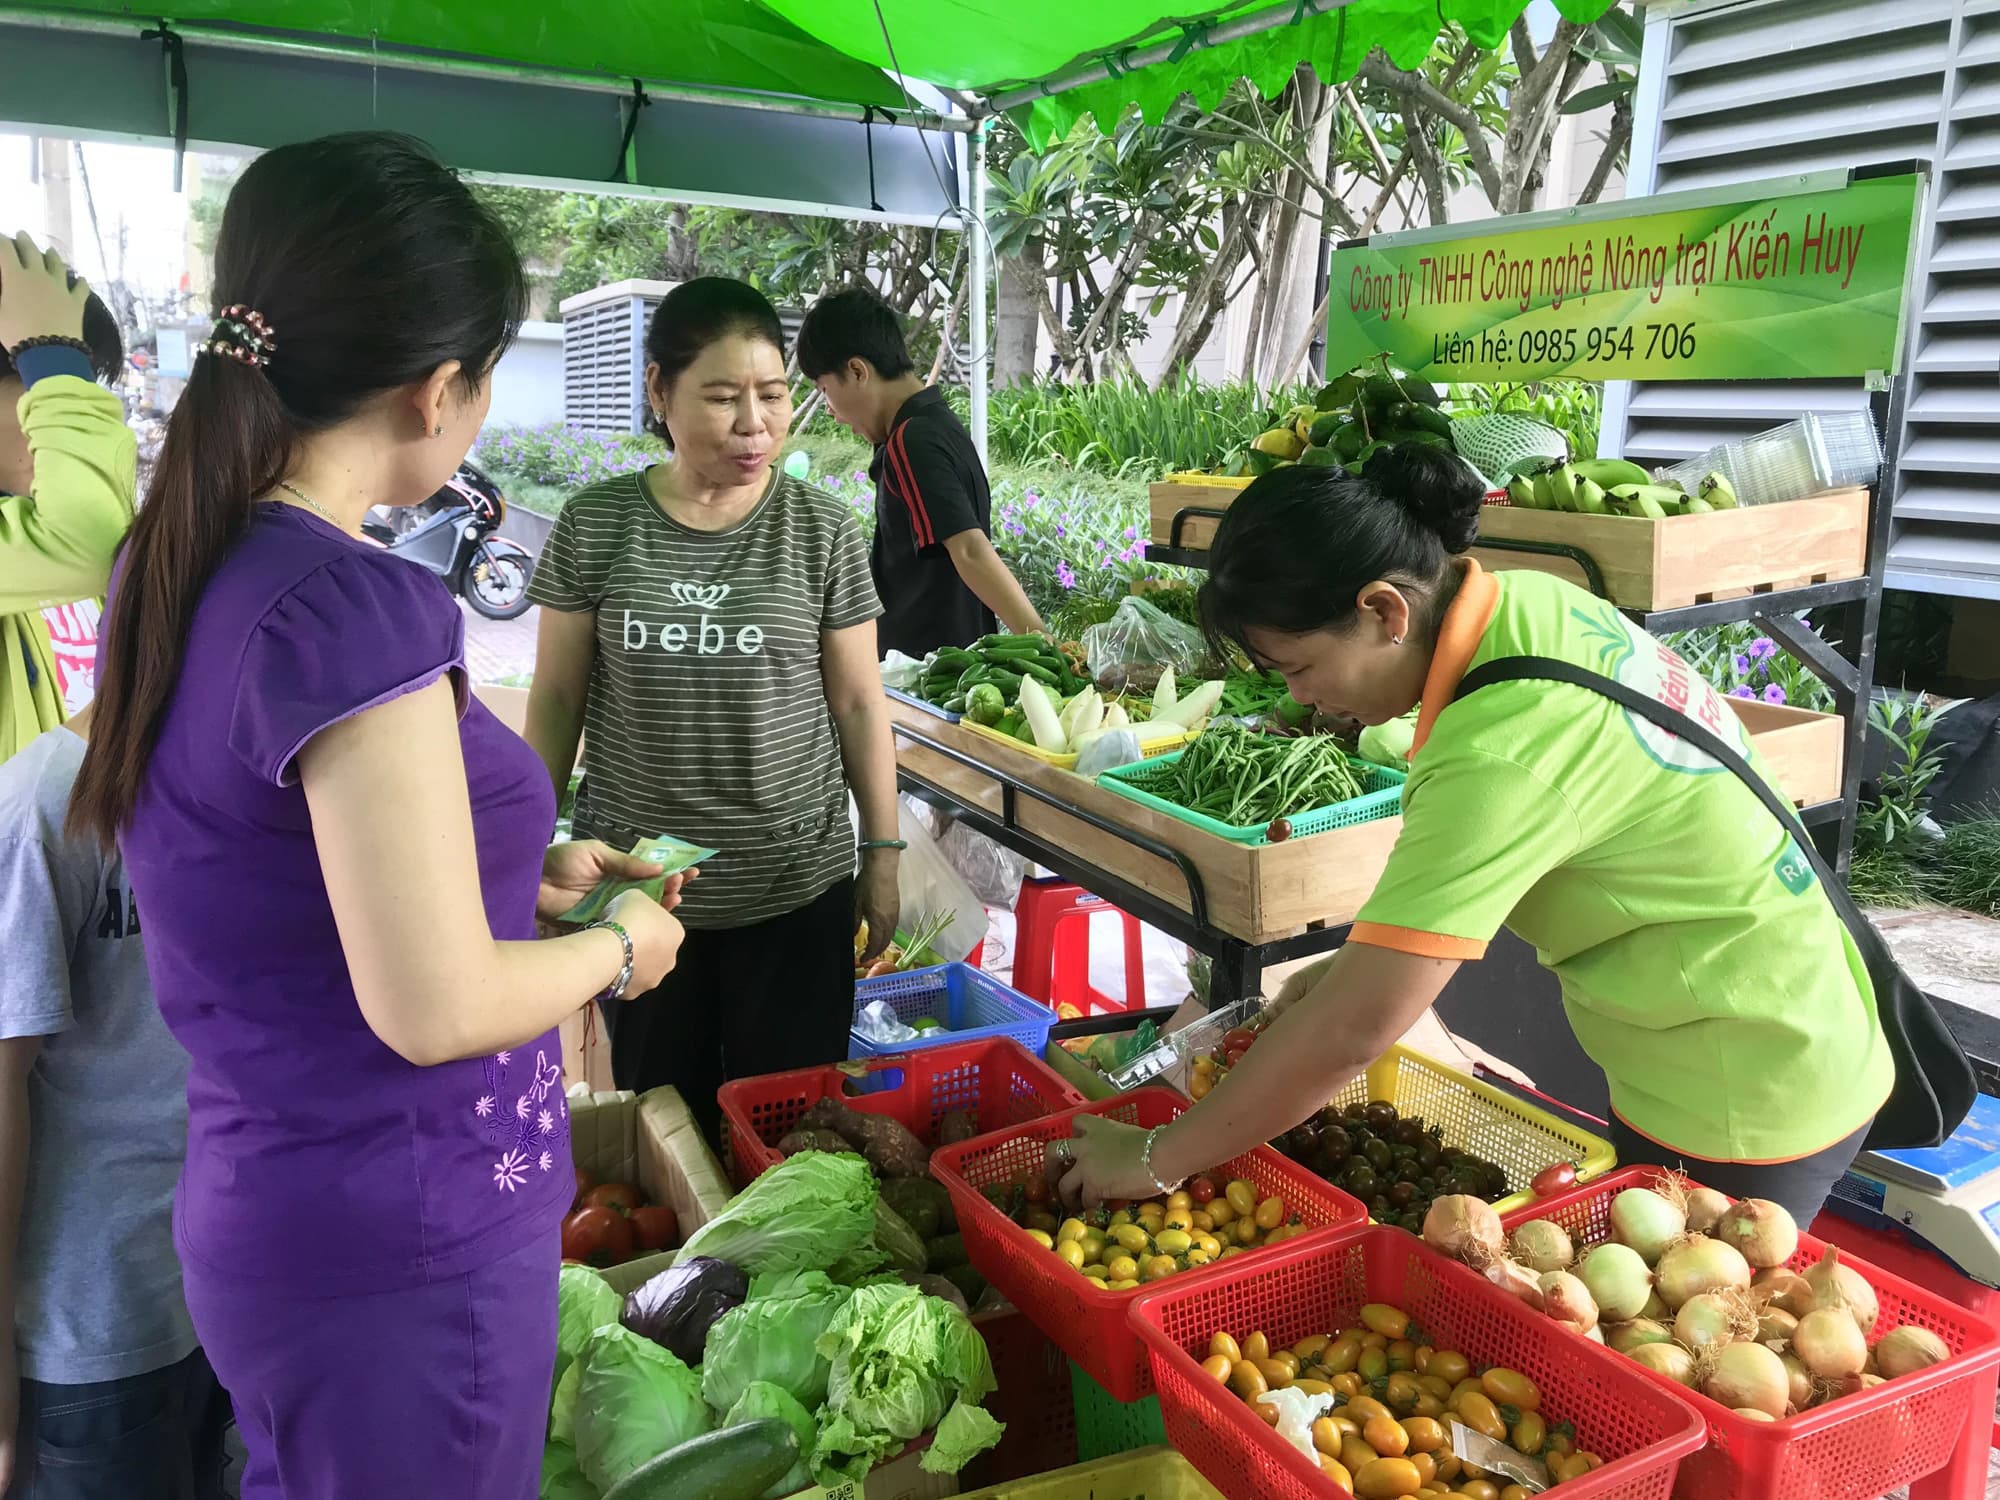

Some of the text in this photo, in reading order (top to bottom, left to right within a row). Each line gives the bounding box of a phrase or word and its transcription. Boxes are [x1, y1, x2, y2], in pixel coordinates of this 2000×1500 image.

[1350, 208, 1865, 321] Công ty TNHH Công nghệ Nông trại Kiến Huy
[1433, 322, 1696, 371] Liên hệ: 0985 954 706
[624, 609, 764, 654] bebe
